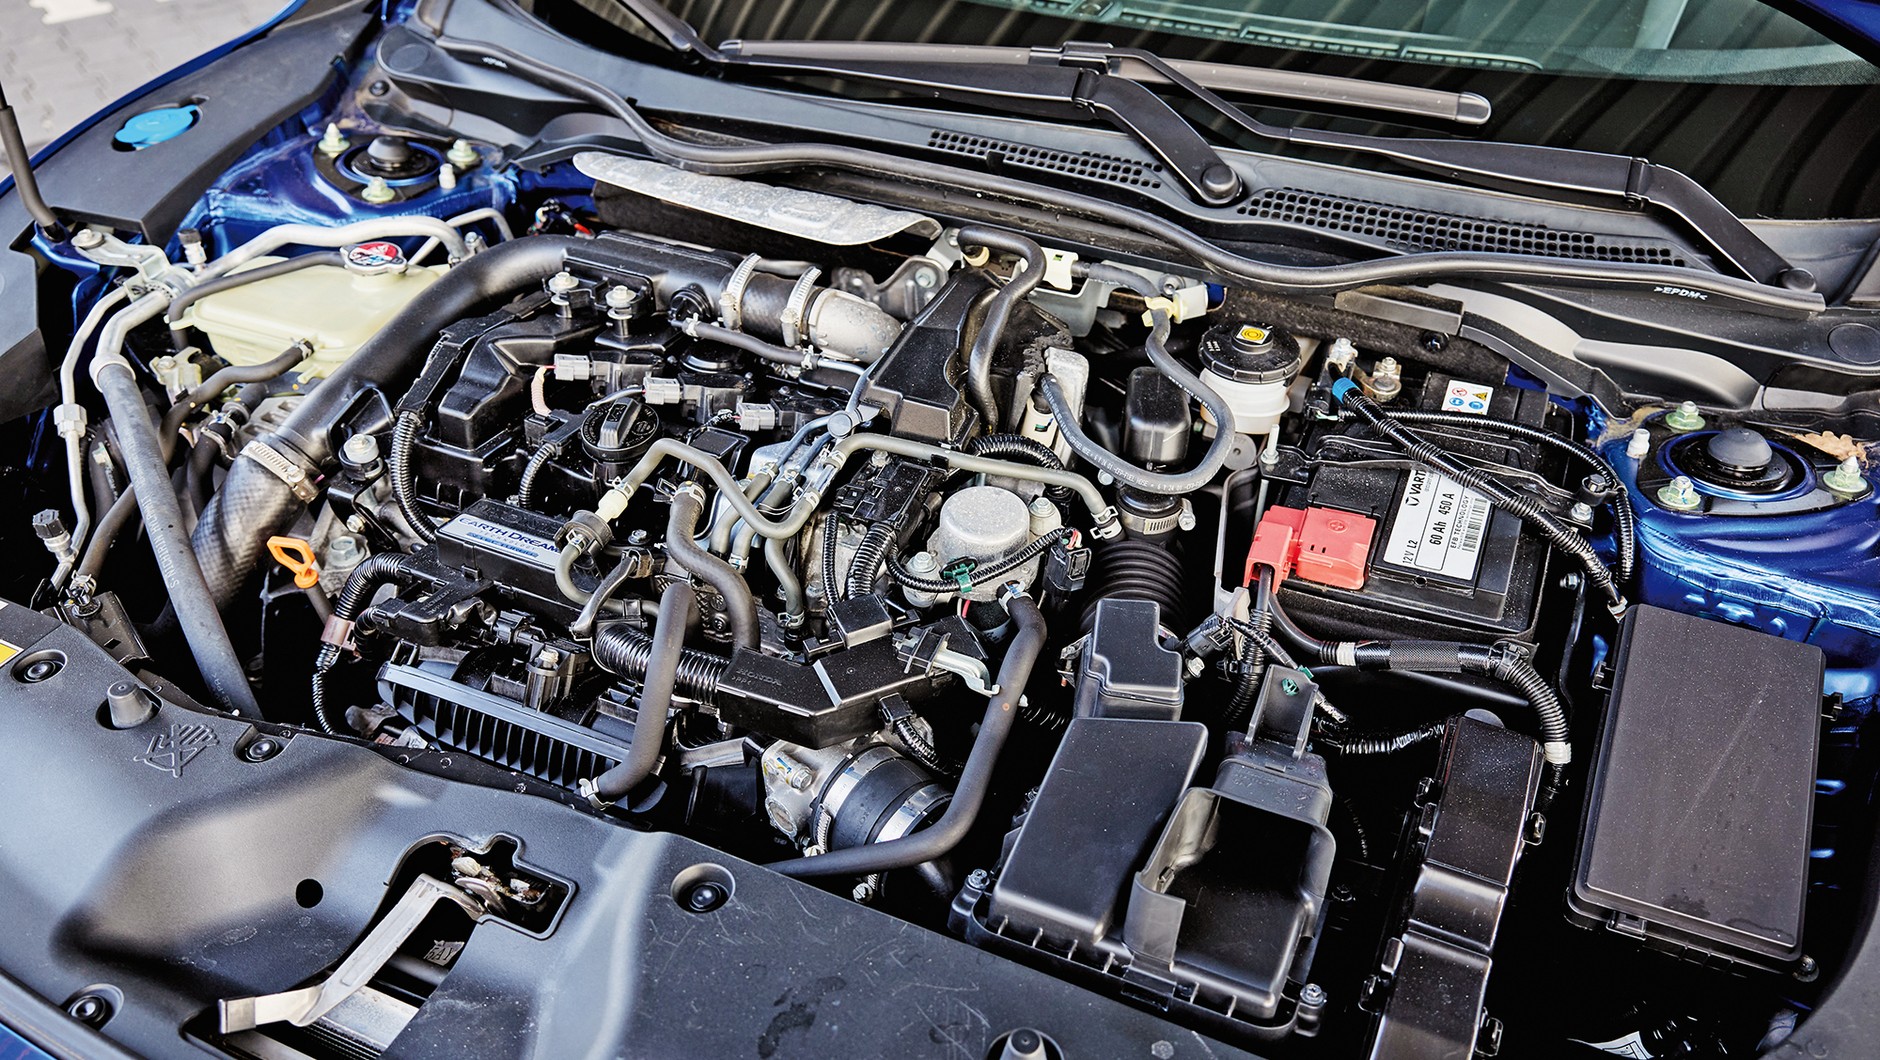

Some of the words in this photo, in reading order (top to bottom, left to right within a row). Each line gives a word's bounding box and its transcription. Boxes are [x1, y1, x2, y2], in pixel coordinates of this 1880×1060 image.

[1438, 500, 1453, 515] 450
[1454, 495, 1470, 535] TECHNOLOGY
[1432, 521, 1447, 534] Ah
[1406, 539, 1418, 549] L2
[1429, 534, 1443, 546] 60
[1450, 537, 1459, 549] EFB
[735, 668, 783, 687] HONDA
